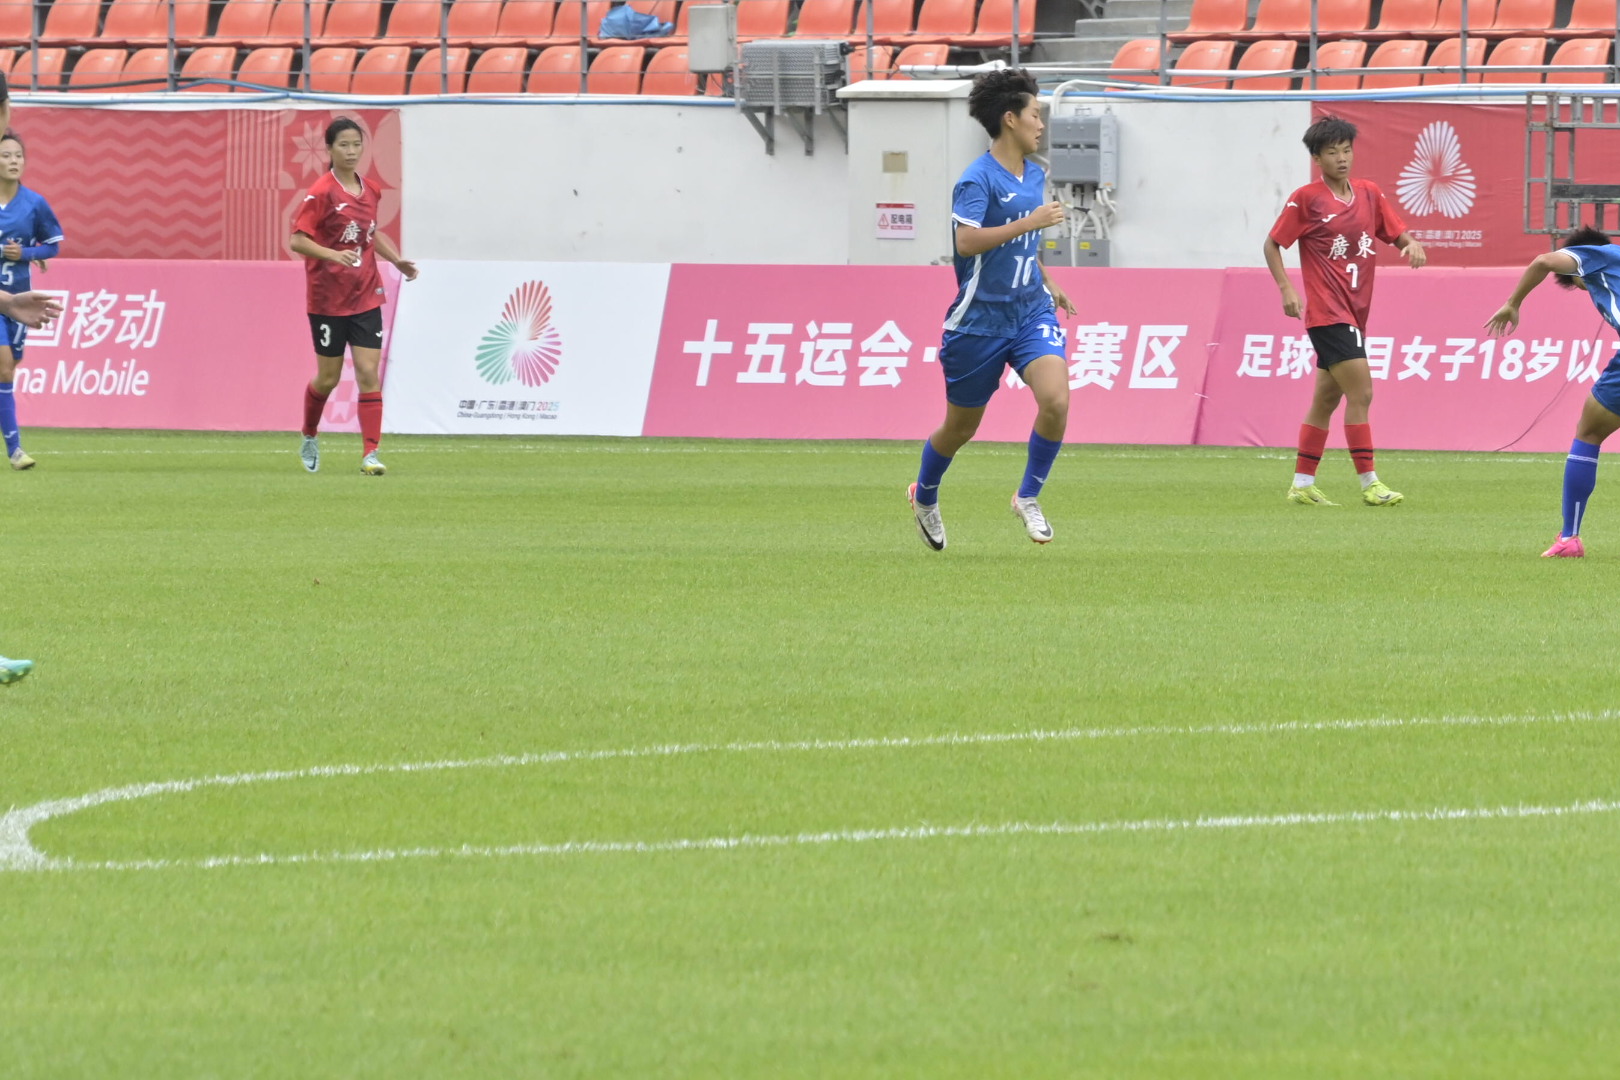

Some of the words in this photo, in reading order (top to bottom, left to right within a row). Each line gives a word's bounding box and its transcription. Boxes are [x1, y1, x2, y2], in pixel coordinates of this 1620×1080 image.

[1328, 231, 1376, 260] 廣東
[1346, 263, 1359, 288] 7
[319, 323, 332, 348] 3
[51, 358, 149, 396] Mobile
